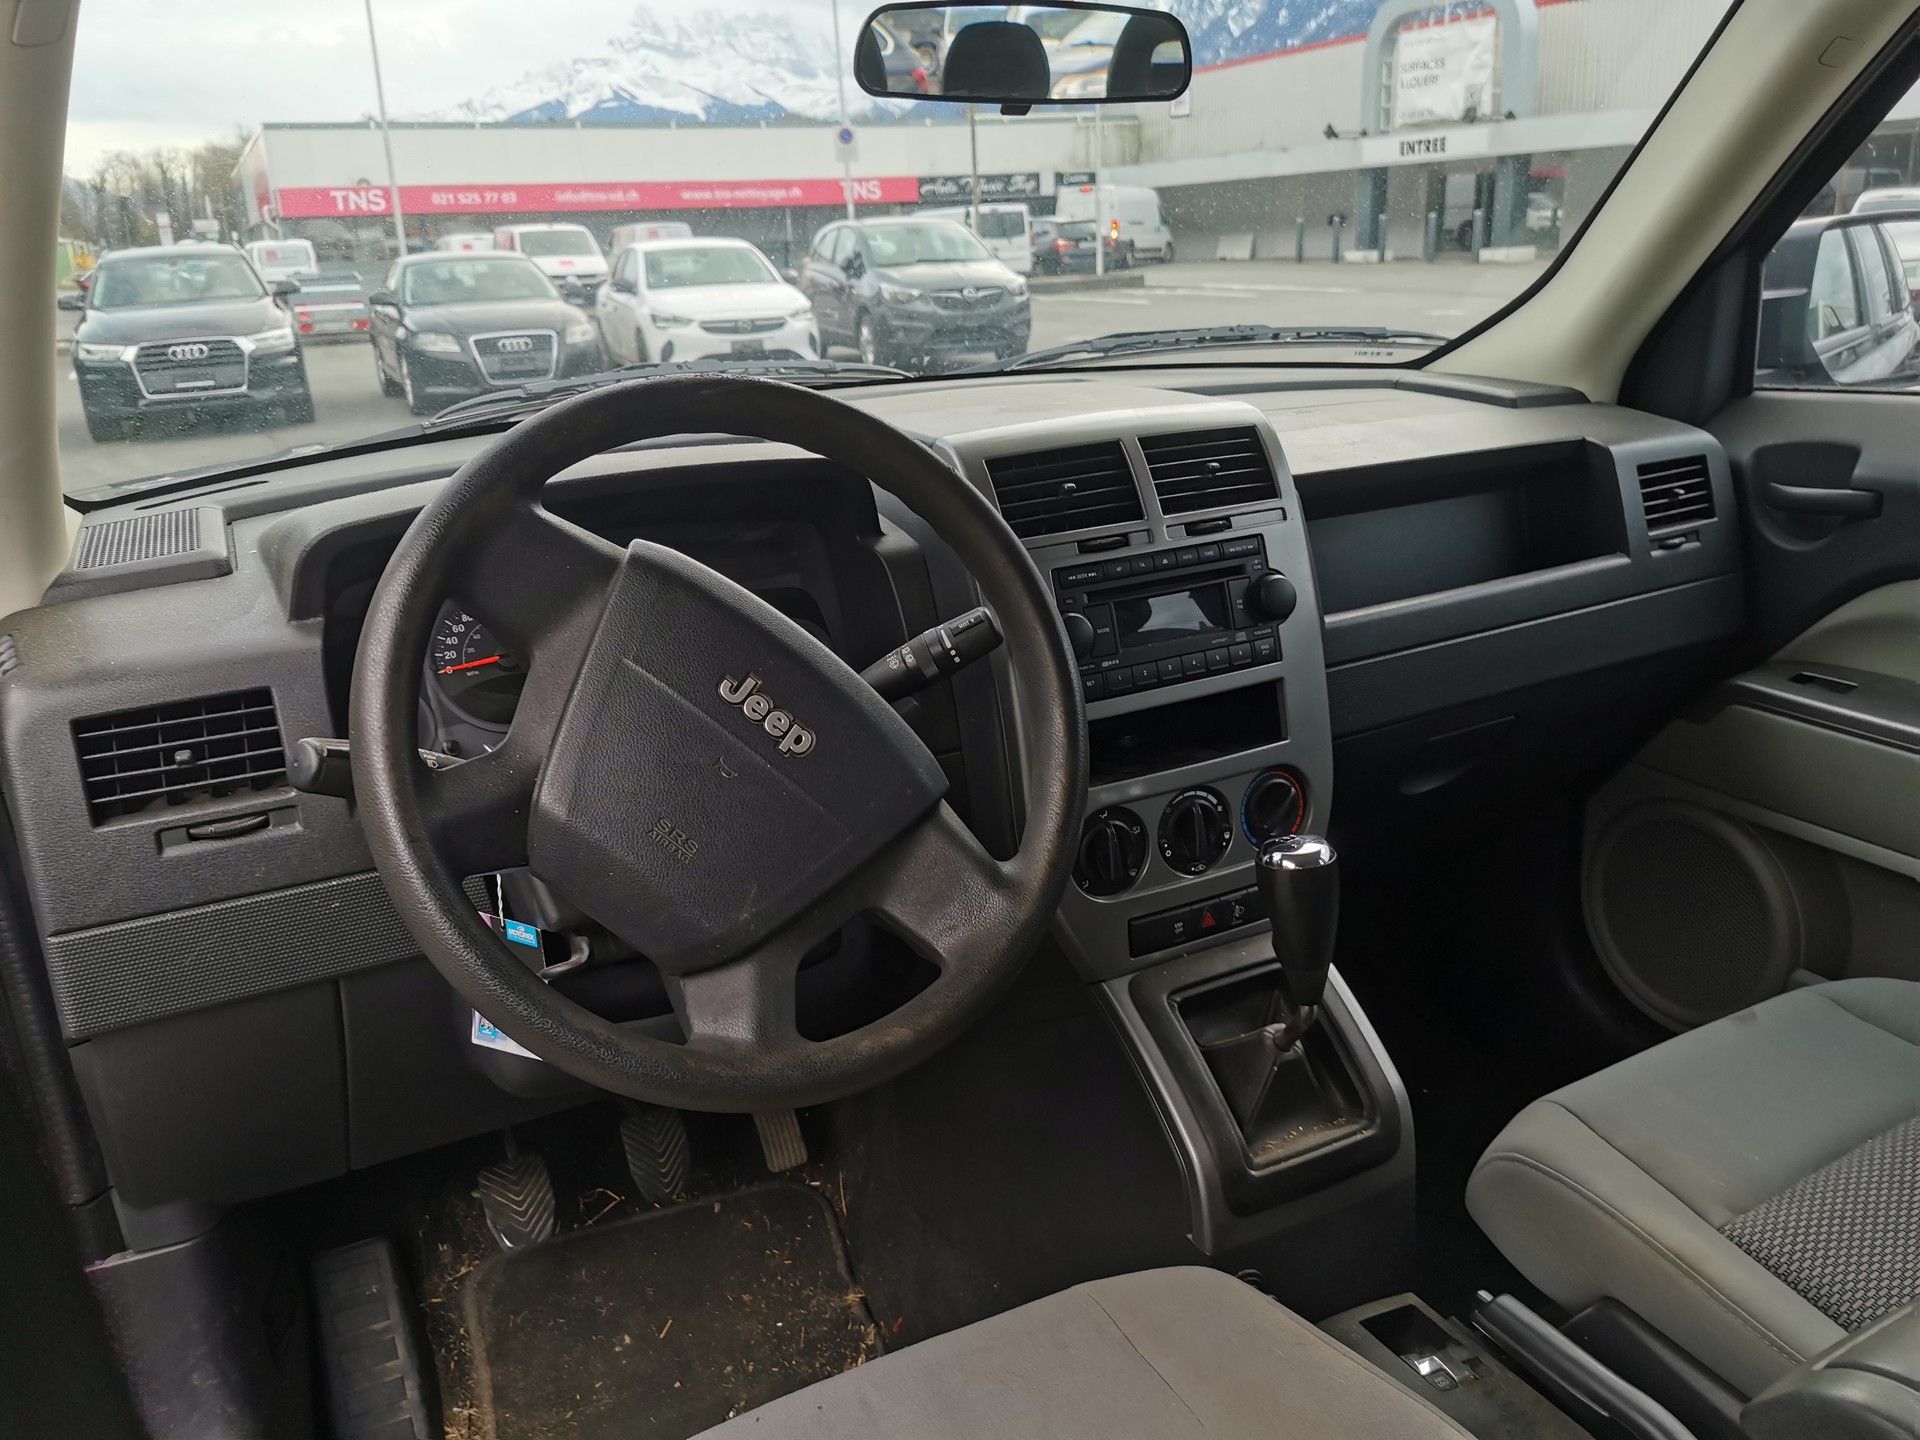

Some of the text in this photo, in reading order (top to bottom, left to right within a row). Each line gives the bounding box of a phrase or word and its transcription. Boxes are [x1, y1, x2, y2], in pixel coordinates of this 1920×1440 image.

[1400, 57, 1447, 73] SURFACES
[330, 189, 386, 212] TNS
[1076, 572, 1089, 580] SEEK
[452, 624, 465, 633] 60
[1096, 626, 1110, 634] MODE
[445, 636, 458, 645] 40
[444, 650, 457, 660] 20
[719, 674, 814, 756] Jeep
[655, 817, 699, 854] SRS
[646, 830, 692, 864] AIRBAG
[508, 928, 534, 941] MOTOREX
